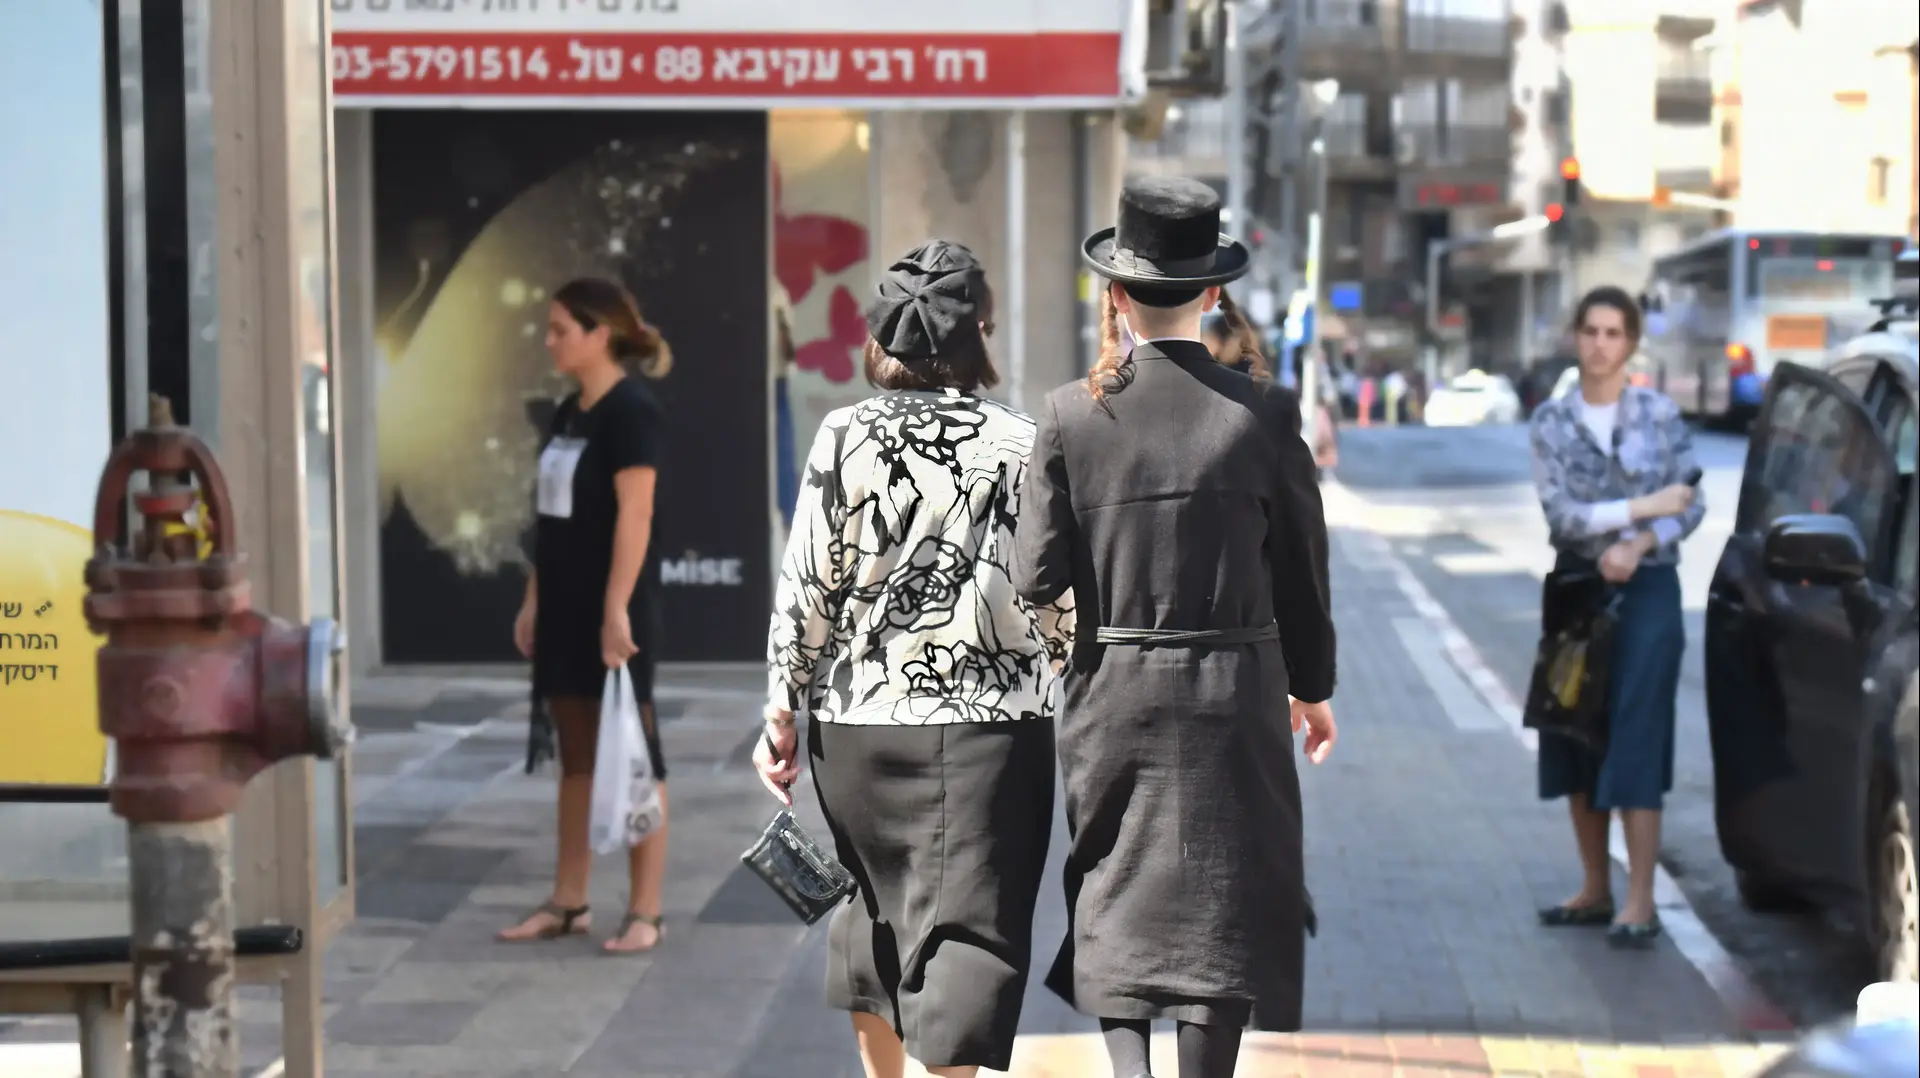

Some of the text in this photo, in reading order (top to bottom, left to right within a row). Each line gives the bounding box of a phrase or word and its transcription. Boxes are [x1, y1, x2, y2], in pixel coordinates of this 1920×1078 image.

[332, 40, 987, 87] רח' רבי עקיבא 88 טל. 03-5791514
